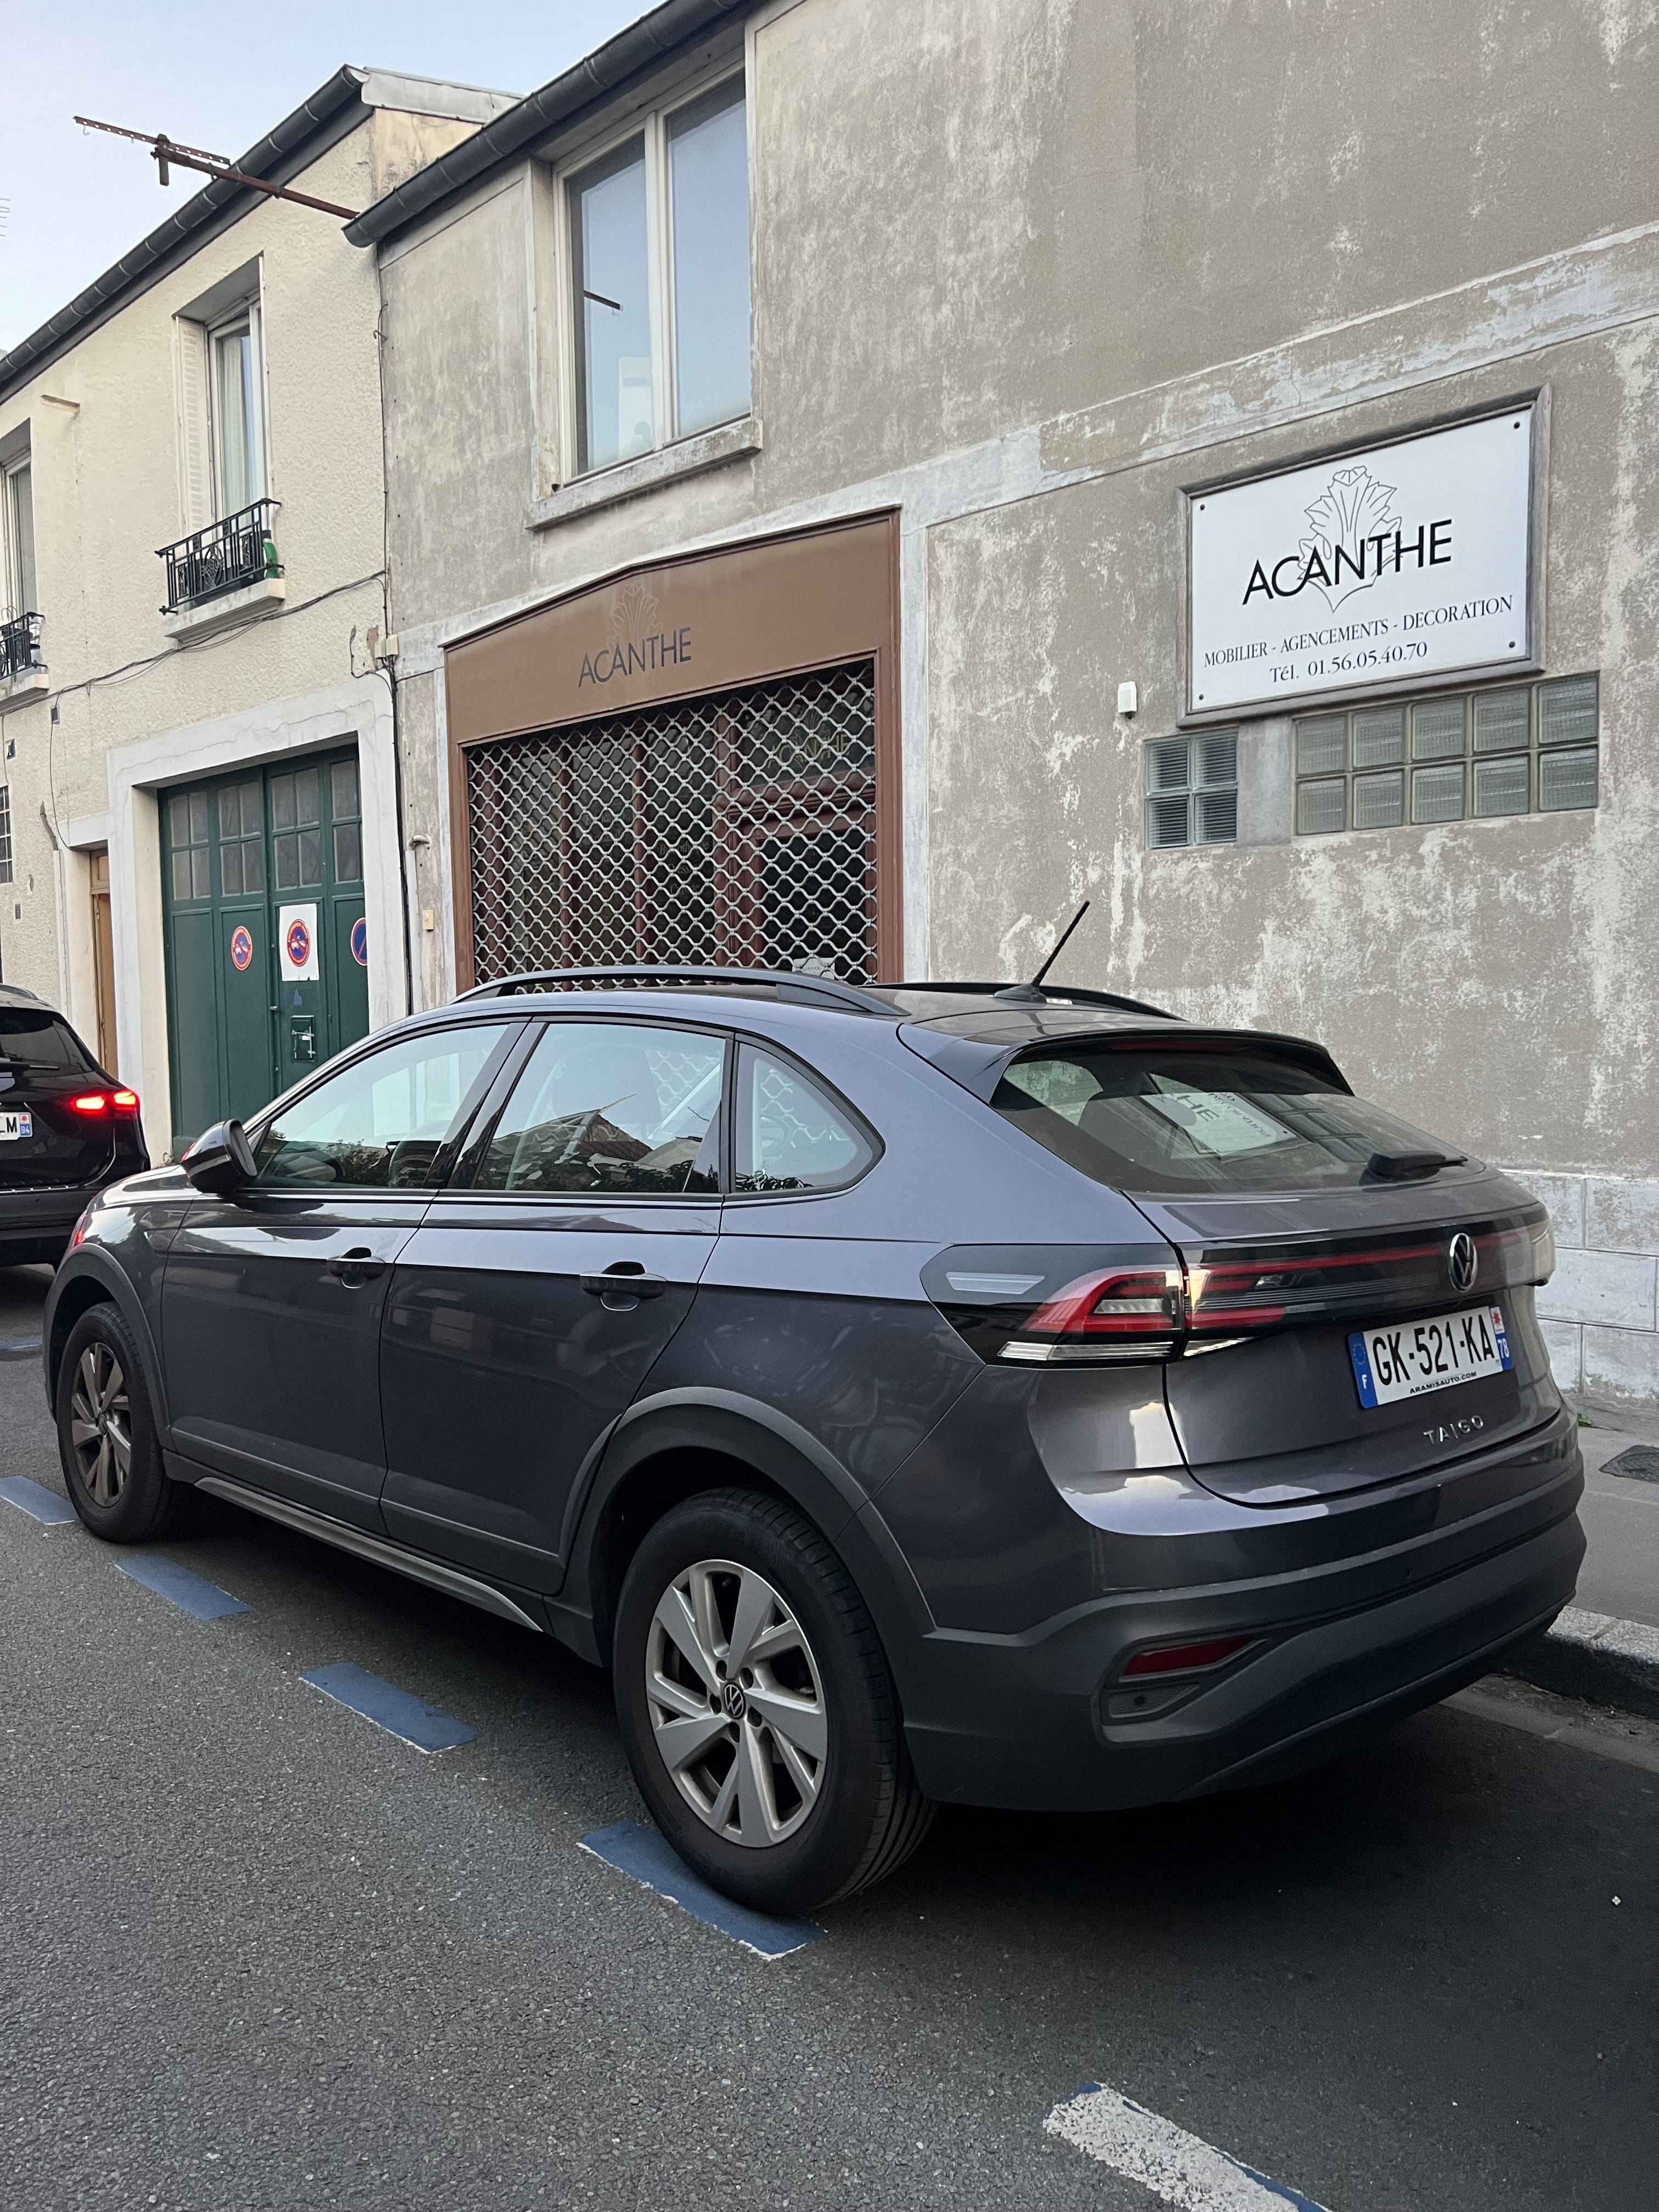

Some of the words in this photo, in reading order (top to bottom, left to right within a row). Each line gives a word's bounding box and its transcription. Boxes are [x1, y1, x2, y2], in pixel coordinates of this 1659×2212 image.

[1242, 519, 1453, 605] ACANTHE
[1204, 642, 1267, 667] MOBILIER
[1280, 618, 1389, 653] AGENCEMENTS
[1403, 595, 1514, 631] DECORATION
[578, 627, 691, 687] ACANTHE
[1269, 665, 1299, 683] Tél.
[1308, 641, 1428, 676] 01.56.05.40.70
[0, 1116, 18, 1133] M
[1497, 1338, 1510, 1358] 78
[1362, 1374, 1367, 1389] F
[1409, 1372, 1477, 1394] ARAMISAUTO.COM
[1423, 1415, 1483, 1444] TAIGO
